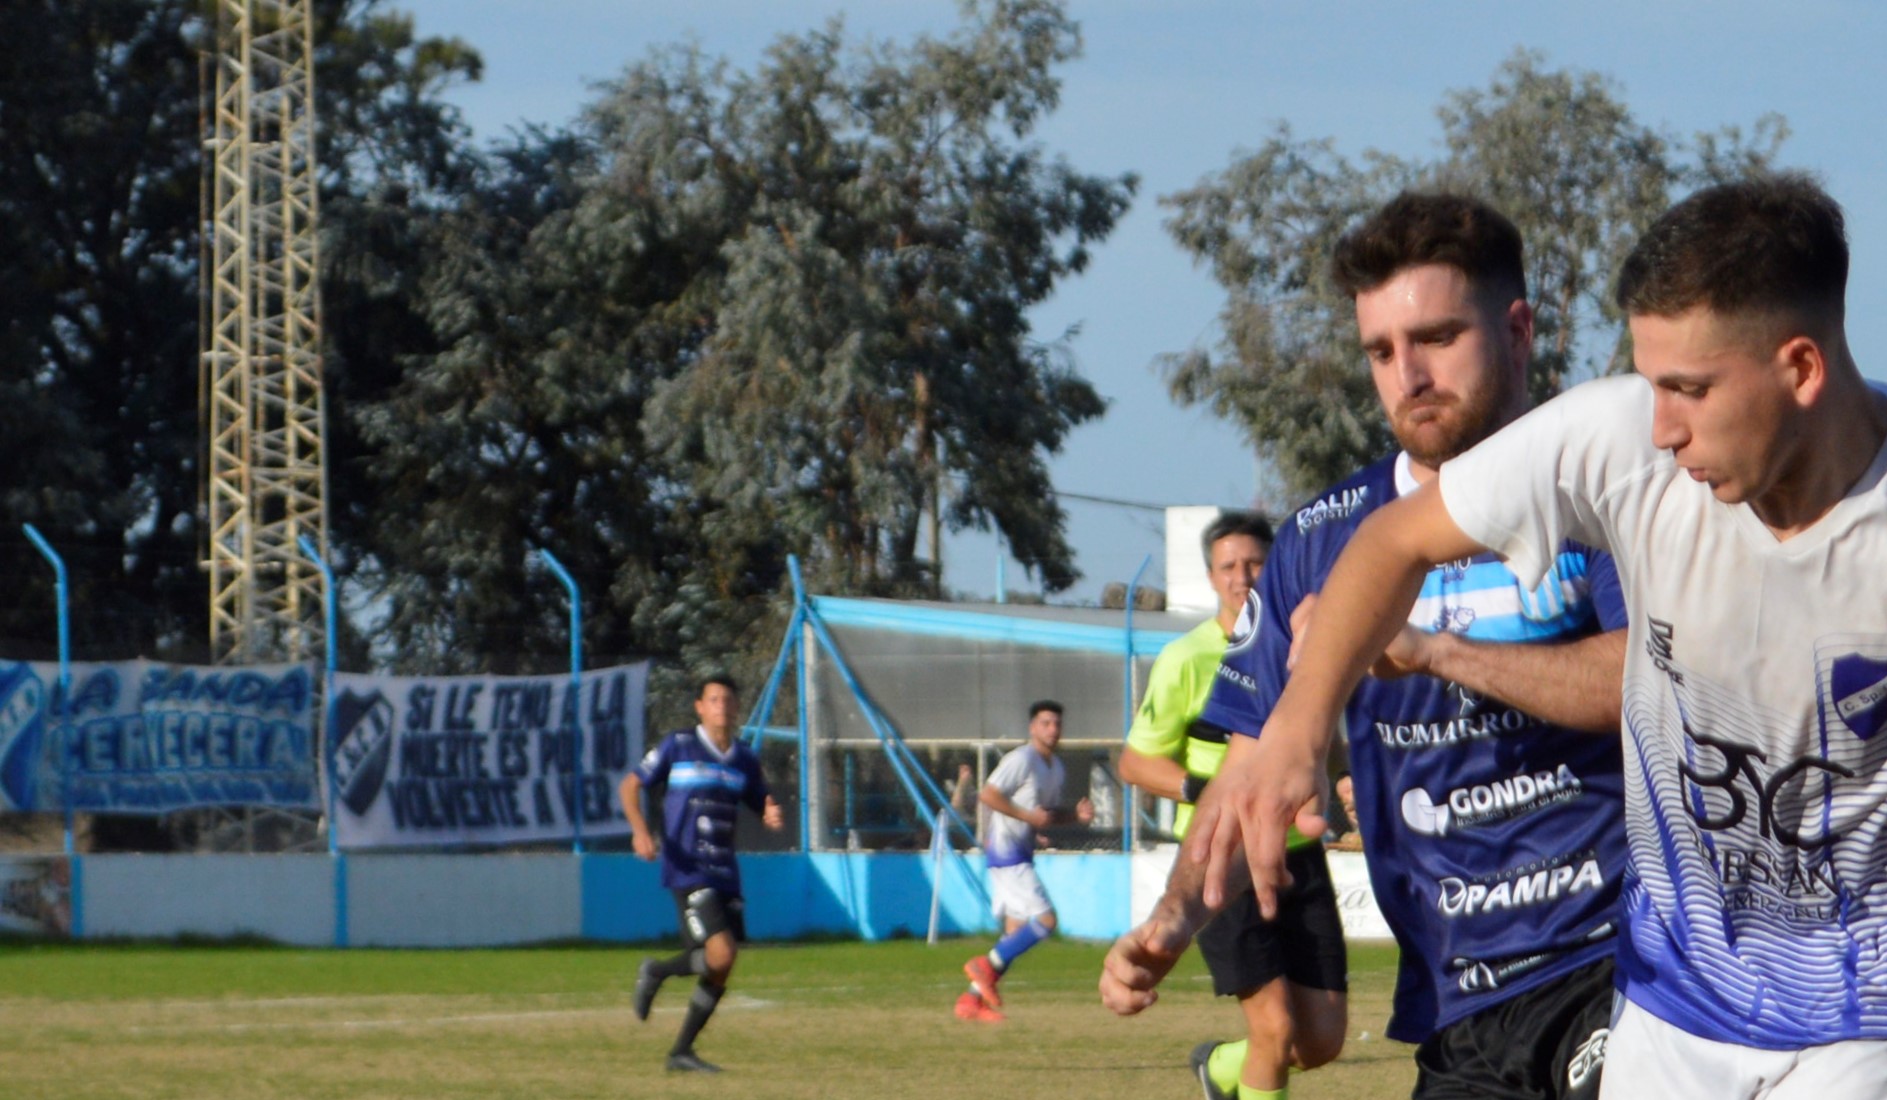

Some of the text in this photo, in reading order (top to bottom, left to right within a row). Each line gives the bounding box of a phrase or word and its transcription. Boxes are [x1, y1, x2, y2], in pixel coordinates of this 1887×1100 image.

[49, 667, 121, 714] LA
[444, 683, 484, 730] LE
[589, 672, 627, 723] LA
[402, 731, 490, 779] MUERTE
[497, 729, 529, 778] ES
[592, 721, 628, 771] NO
[386, 777, 528, 829] VOLVERTE
[532, 777, 555, 826] A
[1450, 763, 1581, 815] GONDRA
[1464, 859, 1605, 915] PAMPA
